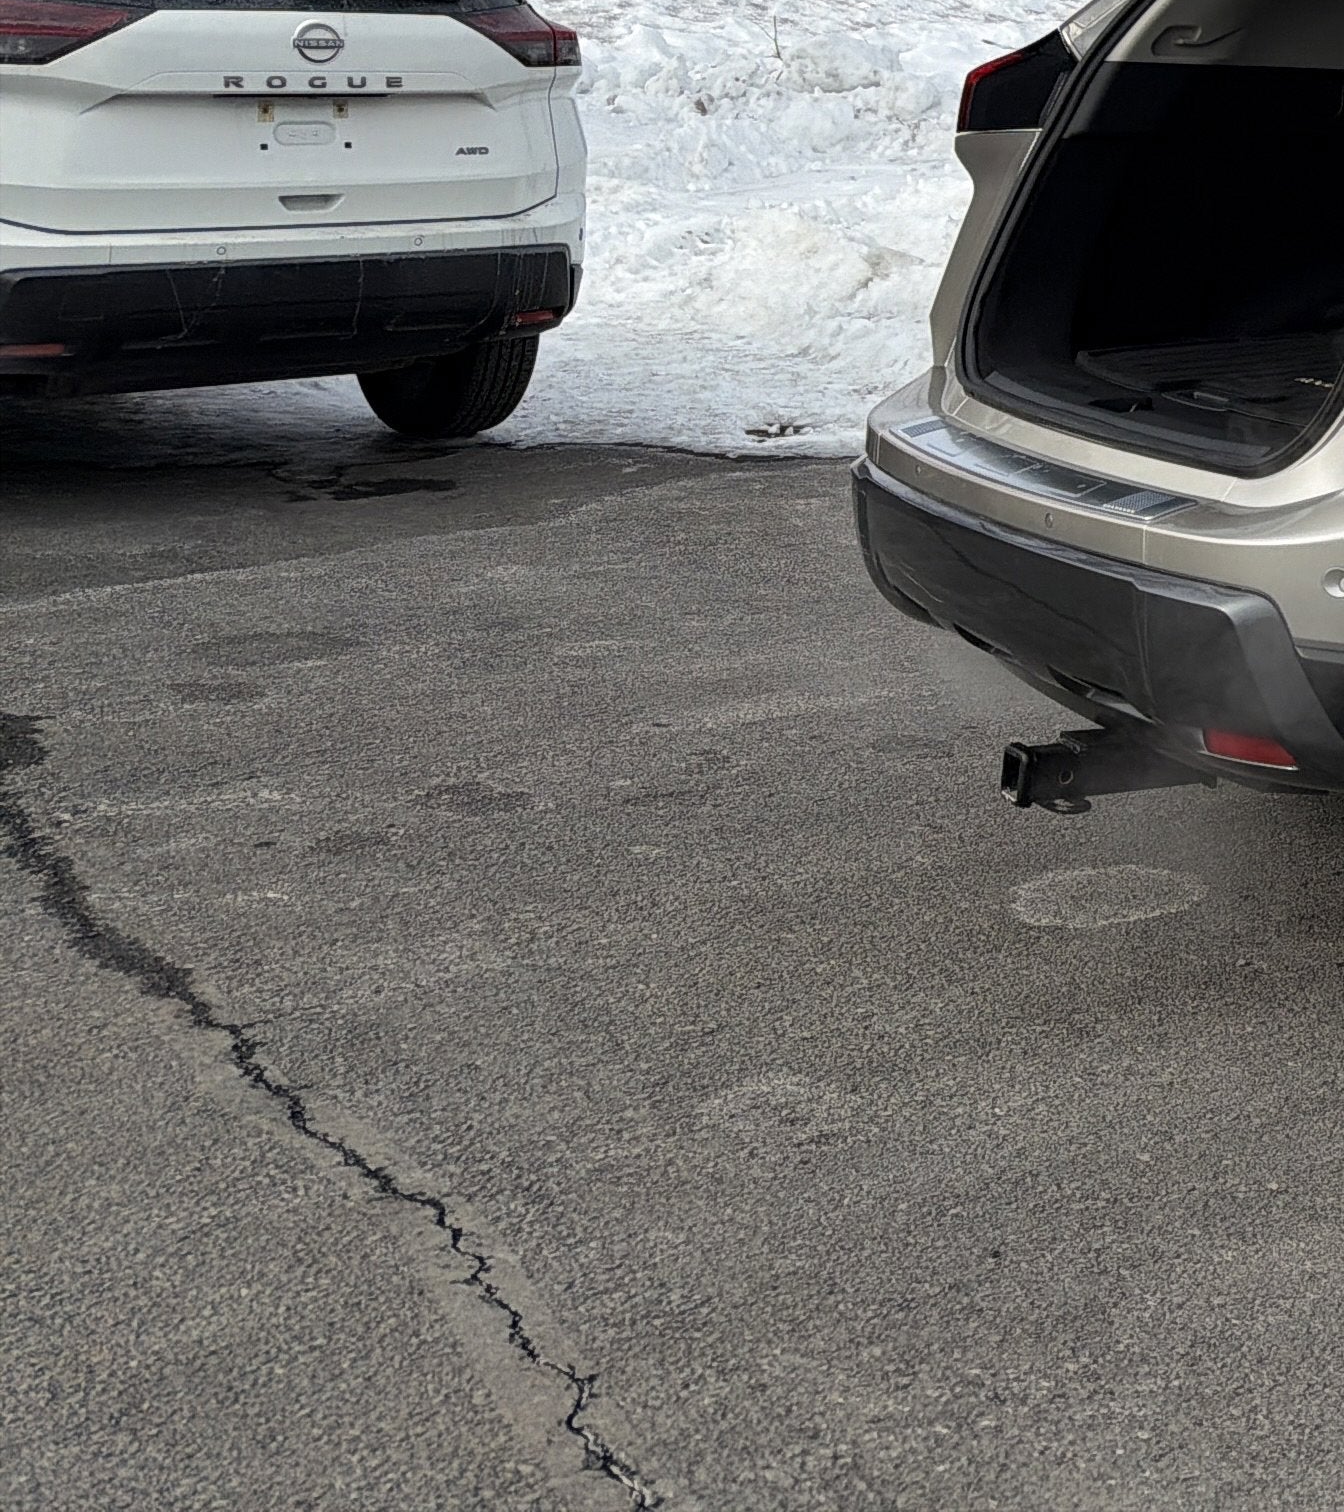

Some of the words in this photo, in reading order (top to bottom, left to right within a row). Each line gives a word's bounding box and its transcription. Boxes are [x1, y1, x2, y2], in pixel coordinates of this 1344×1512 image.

[294, 39, 344, 48] NISSAN
[223, 75, 403, 89] ROGUE
[455, 146, 489, 155] AWD
